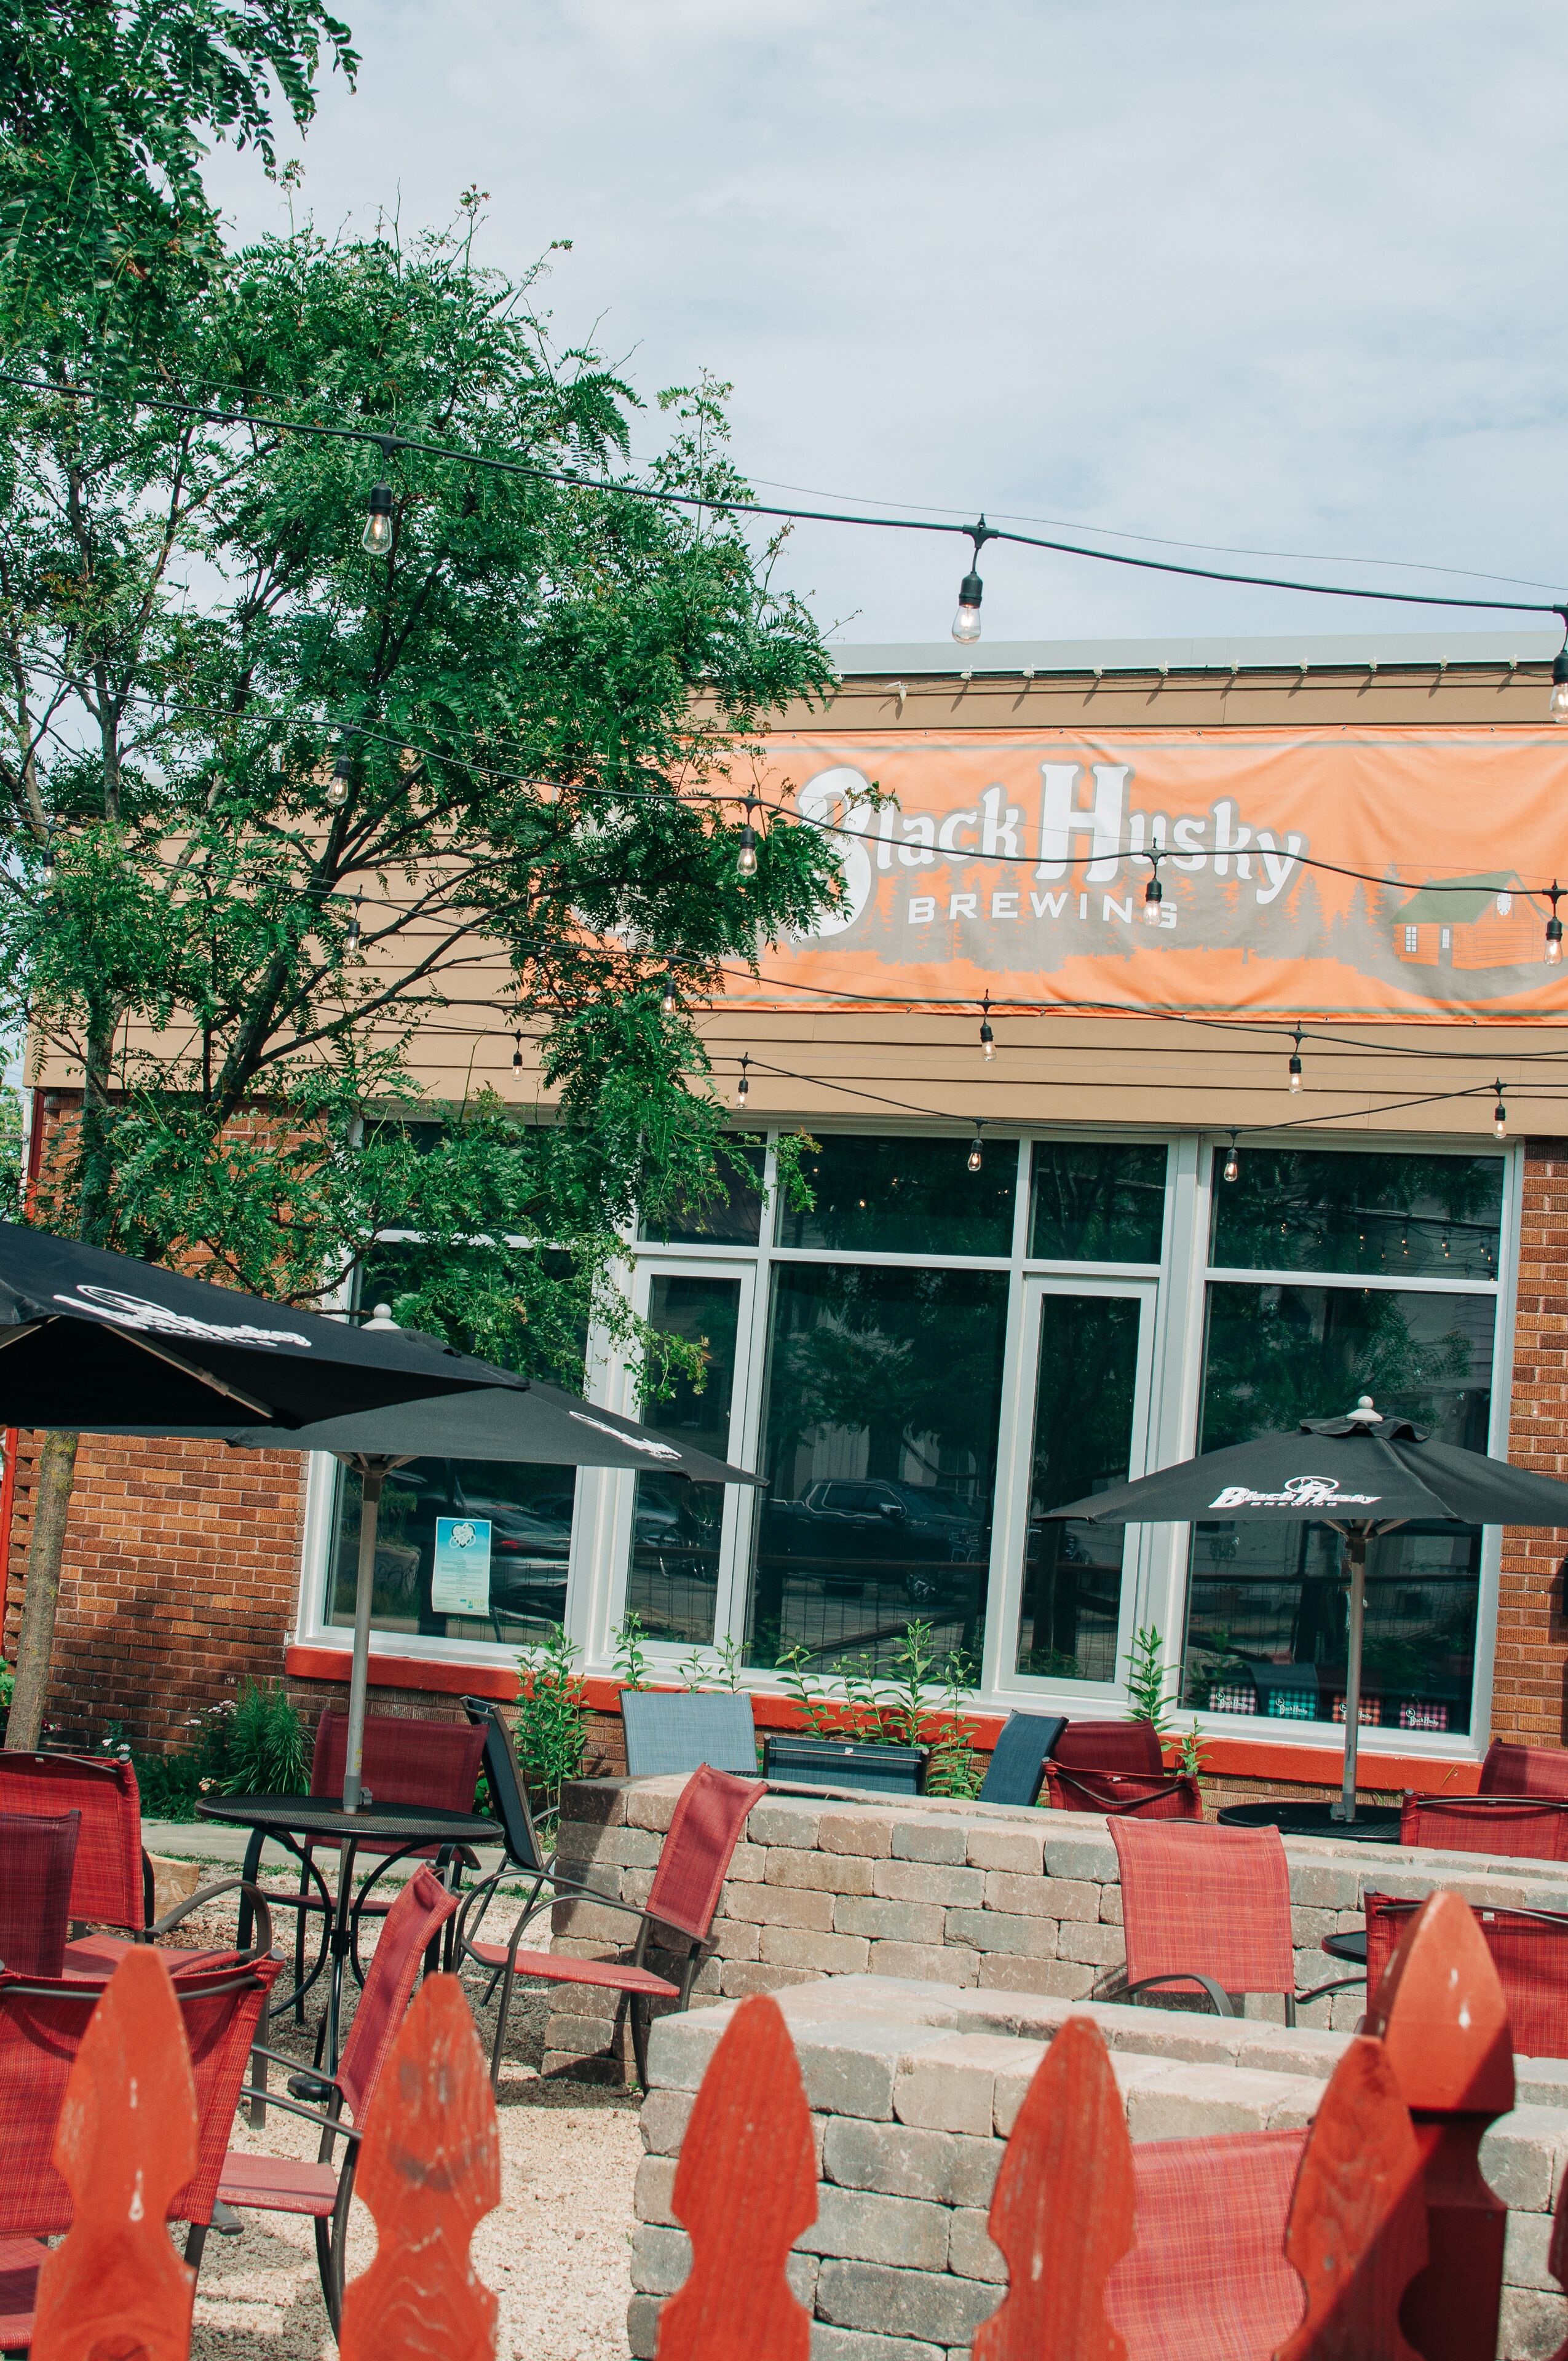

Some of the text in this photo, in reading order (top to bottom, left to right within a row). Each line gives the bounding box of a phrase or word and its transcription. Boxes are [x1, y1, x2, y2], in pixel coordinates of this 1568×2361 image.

[791, 764, 1302, 944] Black Husky
[908, 892, 1178, 930] BREWING
[1208, 1487, 1382, 1508] Black Husky
